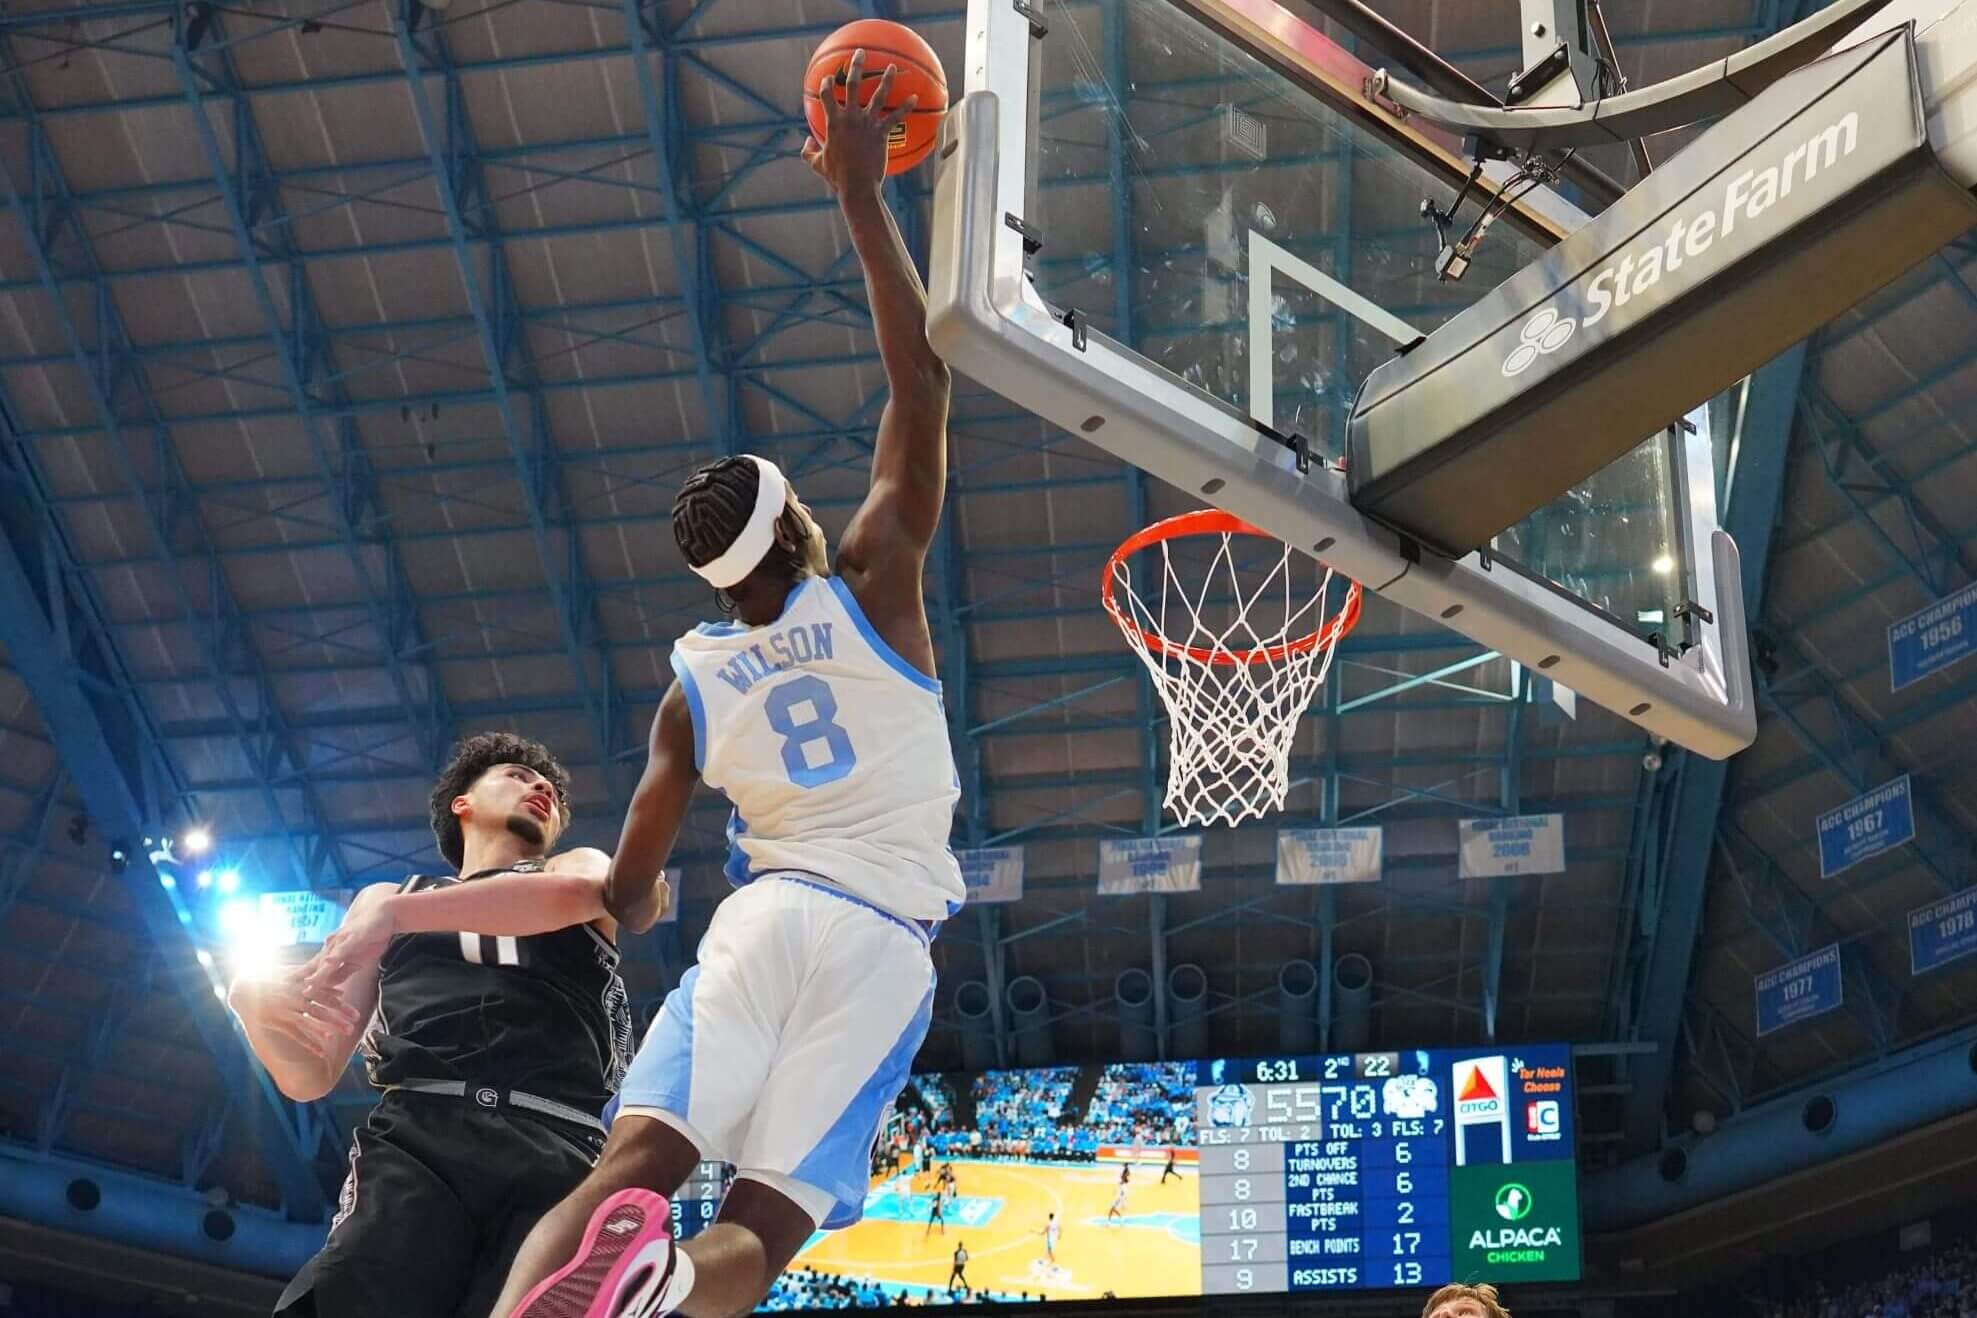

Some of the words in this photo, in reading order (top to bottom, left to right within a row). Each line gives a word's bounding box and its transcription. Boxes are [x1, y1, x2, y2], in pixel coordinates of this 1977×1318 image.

[1892, 619, 1917, 643] ACC
[1920, 615, 1963, 651] 1956
[716, 622, 833, 696] WILSON
[764, 674, 857, 789] 8
[1821, 812, 1842, 832] ACC
[1844, 781, 1905, 821] CHAMPIONS
[1847, 809, 1883, 841] 1967
[1939, 909, 1974, 938] 1978
[1779, 949, 1836, 983] CHAMPIONS
[1783, 975, 1813, 1001] 1977
[1257, 1060, 1299, 1082] 6:31
[1364, 1056, 1390, 1077] 22
[1267, 1088, 1321, 1123] 55
[1322, 1085, 1376, 1120] 70
[1460, 1100, 1498, 1113] CITGO
[1199, 1128, 1232, 1145] FLS:
[1240, 1128, 1250, 1142] 7
[1258, 1126, 1292, 1142] TOL:
[1300, 1126, 1311, 1139] 2
[1330, 1123, 1363, 1138] TOL:
[1371, 1123, 1382, 1136] 3
[1392, 1120, 1425, 1136] FLS:
[1433, 1119, 1444, 1135] 7
[1233, 1149, 1250, 1170] 8
[1295, 1142, 1319, 1157] PTS
[1326, 1141, 1349, 1155] OFF
[1395, 1142, 1412, 1164] 6
[701, 1162, 713, 1180] 4
[1288, 1156, 1358, 1171] TURNOVERS
[1234, 1179, 1251, 1200] 8
[1288, 1174, 1310, 1187] 2ND
[1316, 1172, 1358, 1186] CHANCE
[1396, 1172, 1413, 1194] 6
[701, 1183, 713, 1199] 2
[1312, 1188, 1335, 1201] PTS
[701, 1201, 714, 1219] 0
[1229, 1209, 1257, 1230] 10
[1289, 1202, 1359, 1217] FASTBREAK
[1397, 1203, 1414, 1224] 2
[1311, 1217, 1336, 1231] PTS
[1290, 1240, 1320, 1255] BENCH
[1324, 1238, 1360, 1254] POINTS
[1393, 1232, 1420, 1255] 17
[1468, 1227, 1562, 1249] ALPACA
[1230, 1239, 1257, 1261] 17
[1487, 1250, 1545, 1264] CHICKEN
[1236, 1269, 1253, 1290] 9
[1293, 1268, 1358, 1285] ASSISTS
[1393, 1262, 1422, 1285] 13
